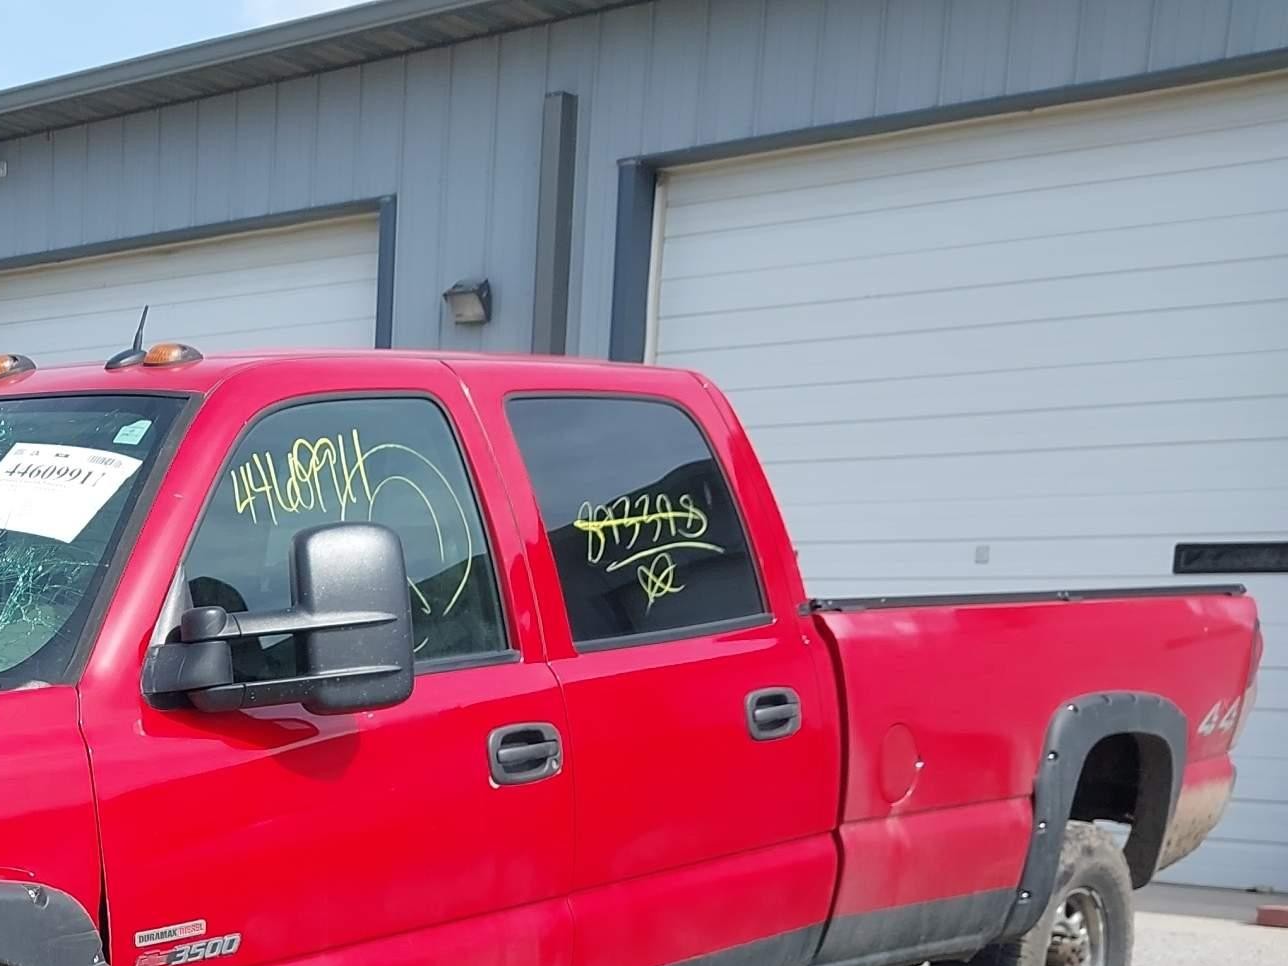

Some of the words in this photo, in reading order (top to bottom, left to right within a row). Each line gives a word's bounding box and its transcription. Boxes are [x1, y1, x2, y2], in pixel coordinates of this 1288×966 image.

[139, 928, 177, 944] DURAMAX
[178, 922, 204, 936] DIESEL
[170, 933, 241, 966] 3500
